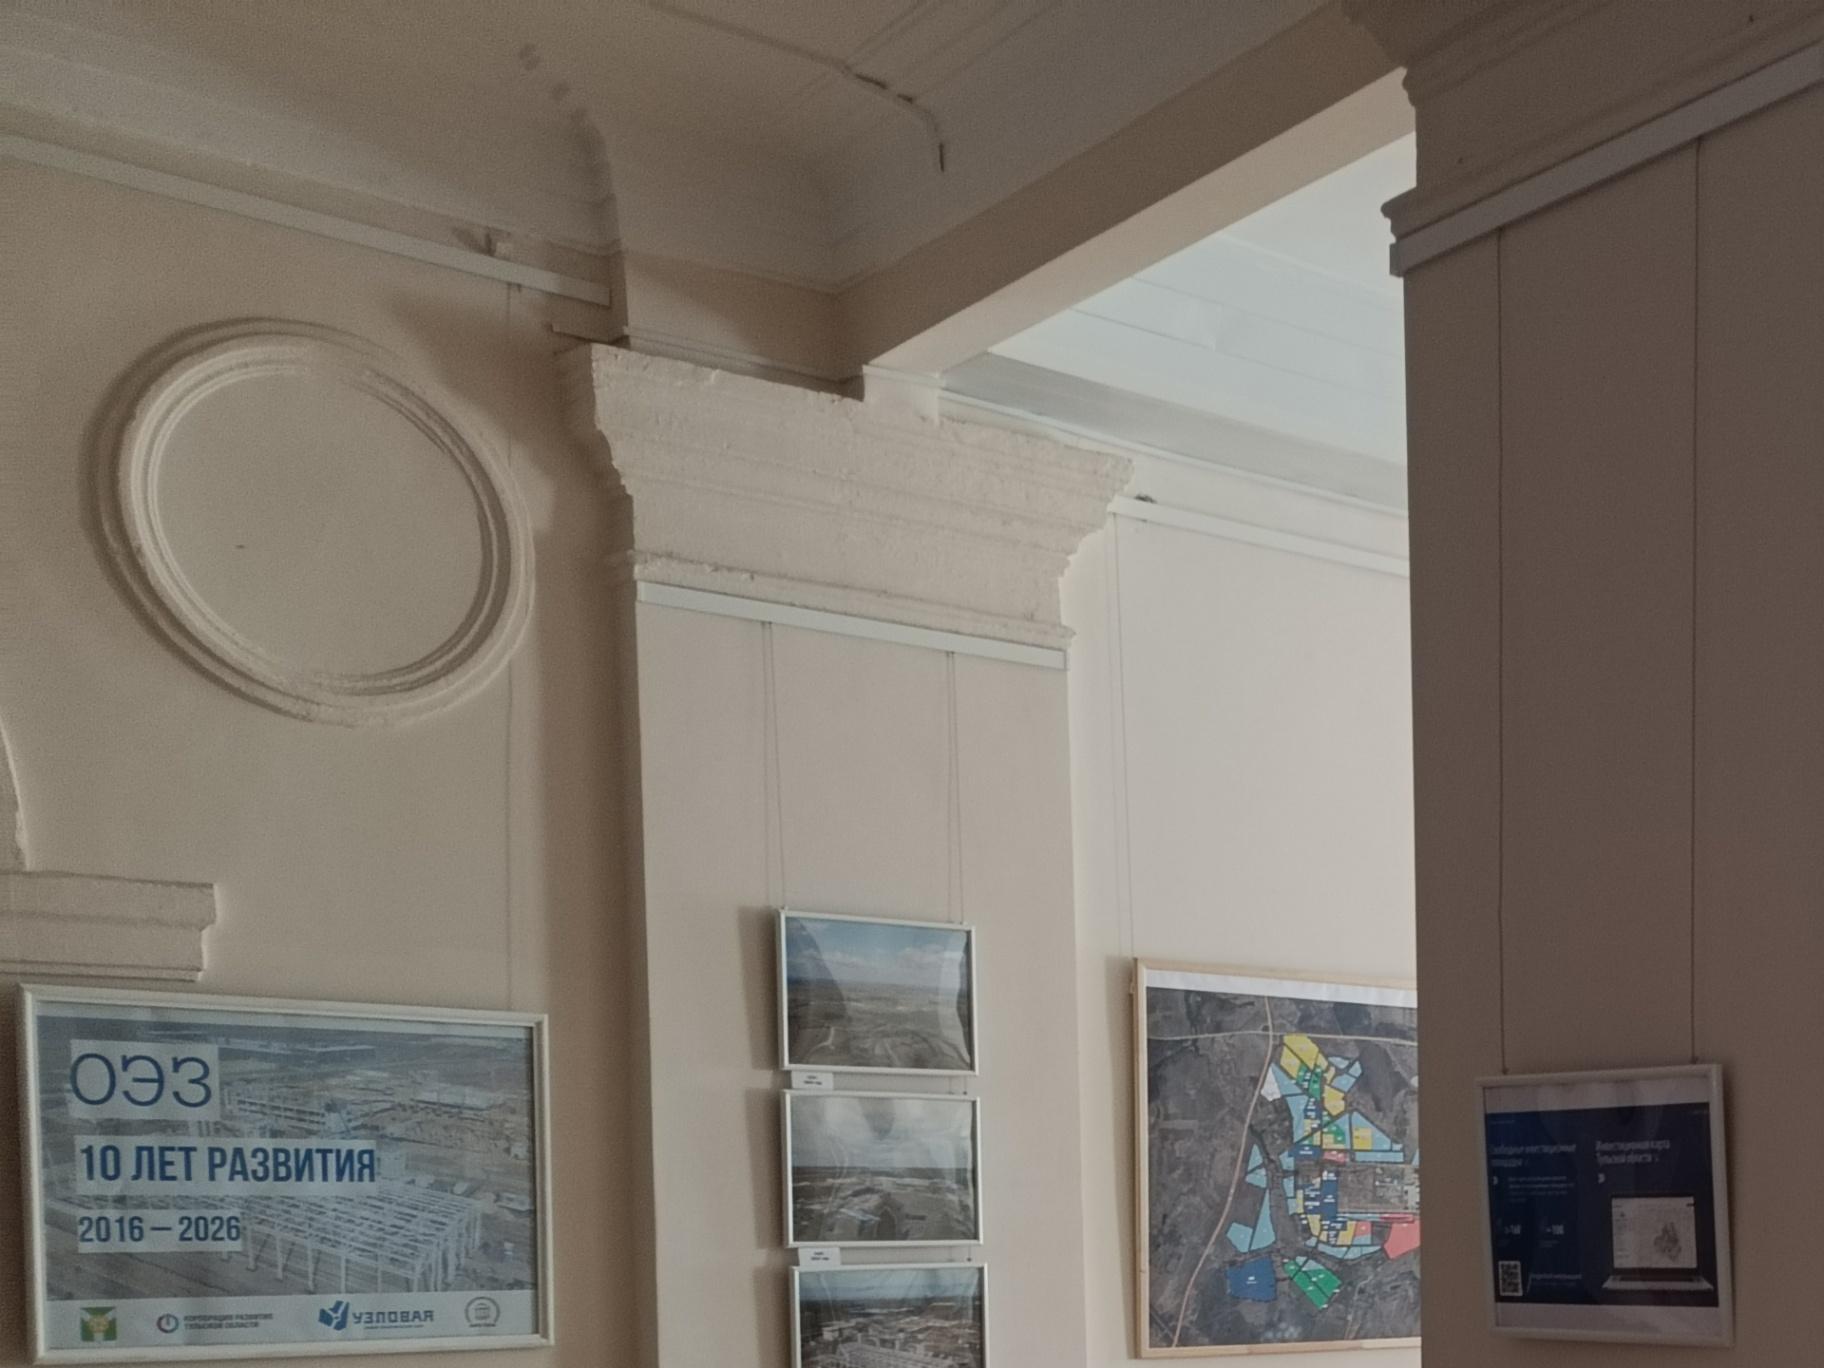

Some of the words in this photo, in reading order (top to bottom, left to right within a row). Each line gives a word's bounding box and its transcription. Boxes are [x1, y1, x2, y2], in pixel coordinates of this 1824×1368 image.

[69, 1053, 212, 1108] ОЭЗ
[80, 1144, 121, 1181] 10
[130, 1145, 198, 1182] ЛЕТ
[207, 1146, 376, 1183] РАЗВИТИЯ
[78, 1215, 144, 1243] 2016
[178, 1215, 242, 1242] 2026
